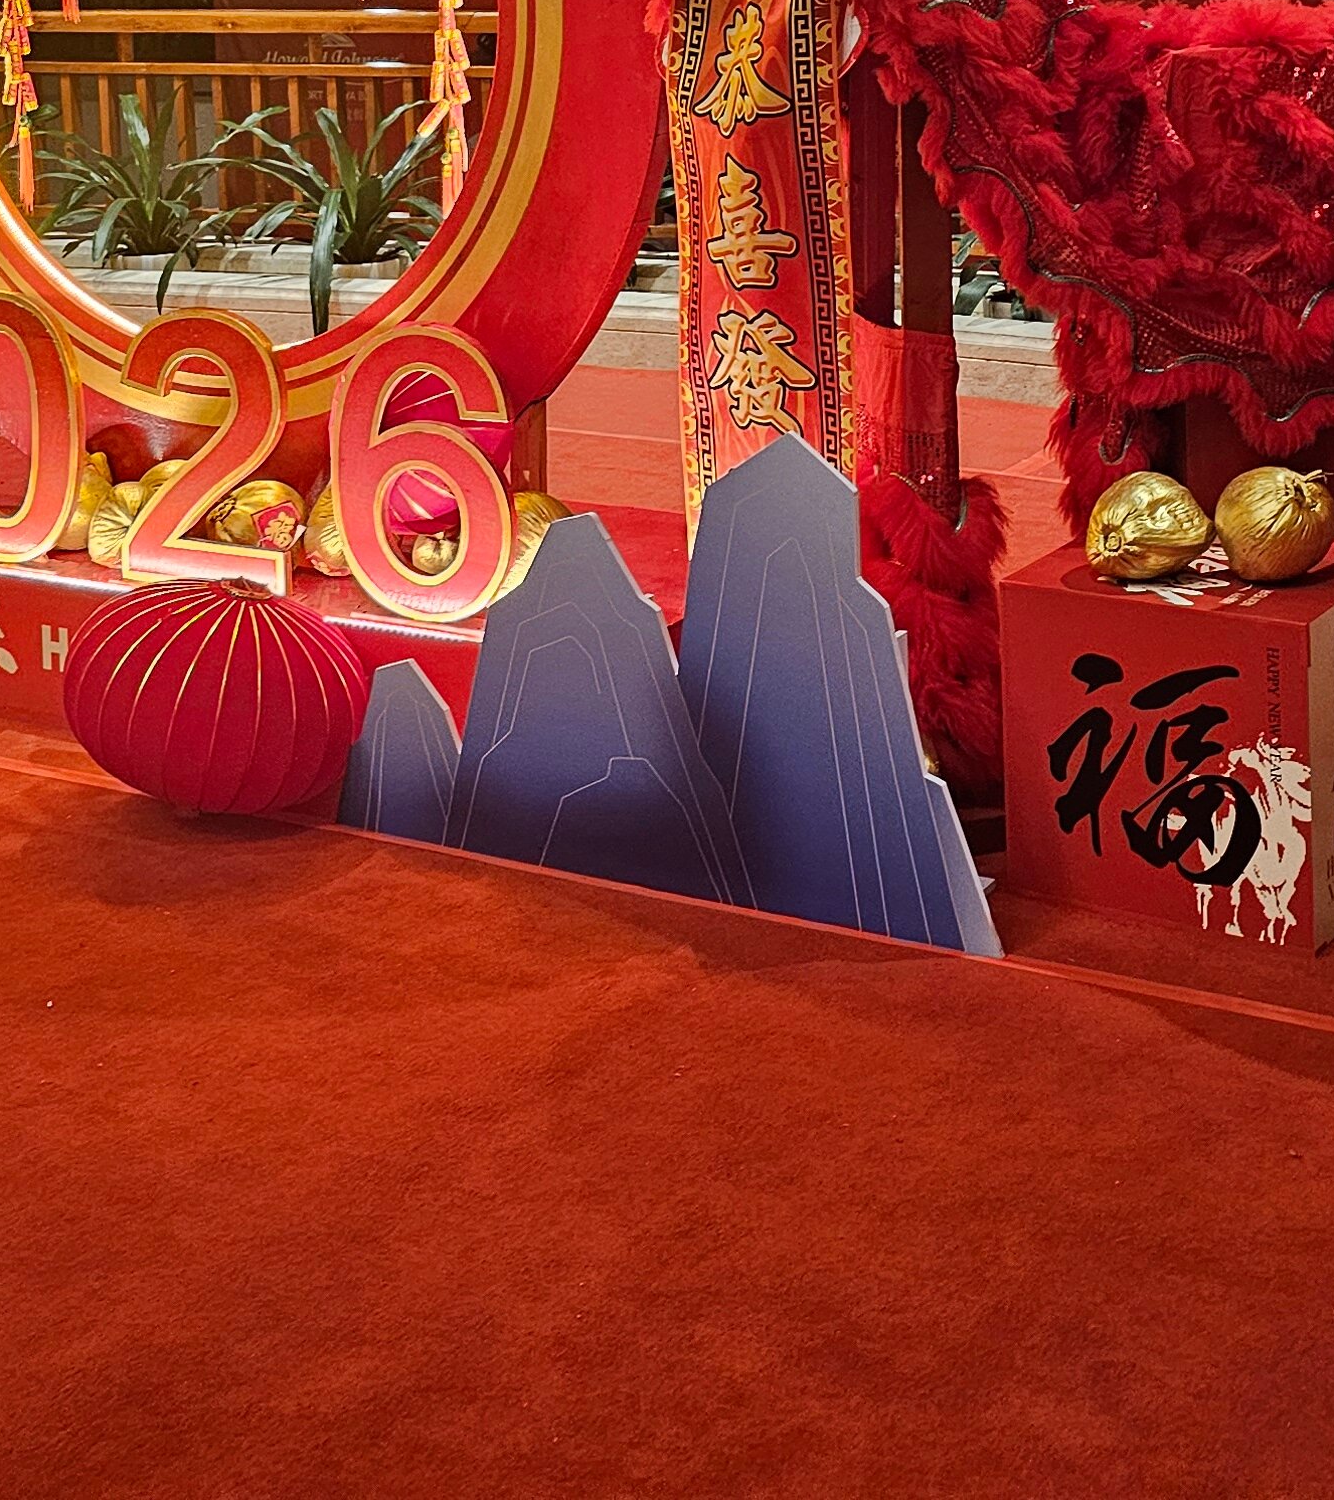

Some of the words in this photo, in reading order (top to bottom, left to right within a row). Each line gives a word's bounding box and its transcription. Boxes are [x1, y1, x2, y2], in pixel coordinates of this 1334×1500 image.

[1266, 647, 1281, 698] HAPPY
[1267, 702, 1282, 741] NEW
[1047, 653, 1262, 887] 福
[1269, 744, 1283, 784] YEAR
